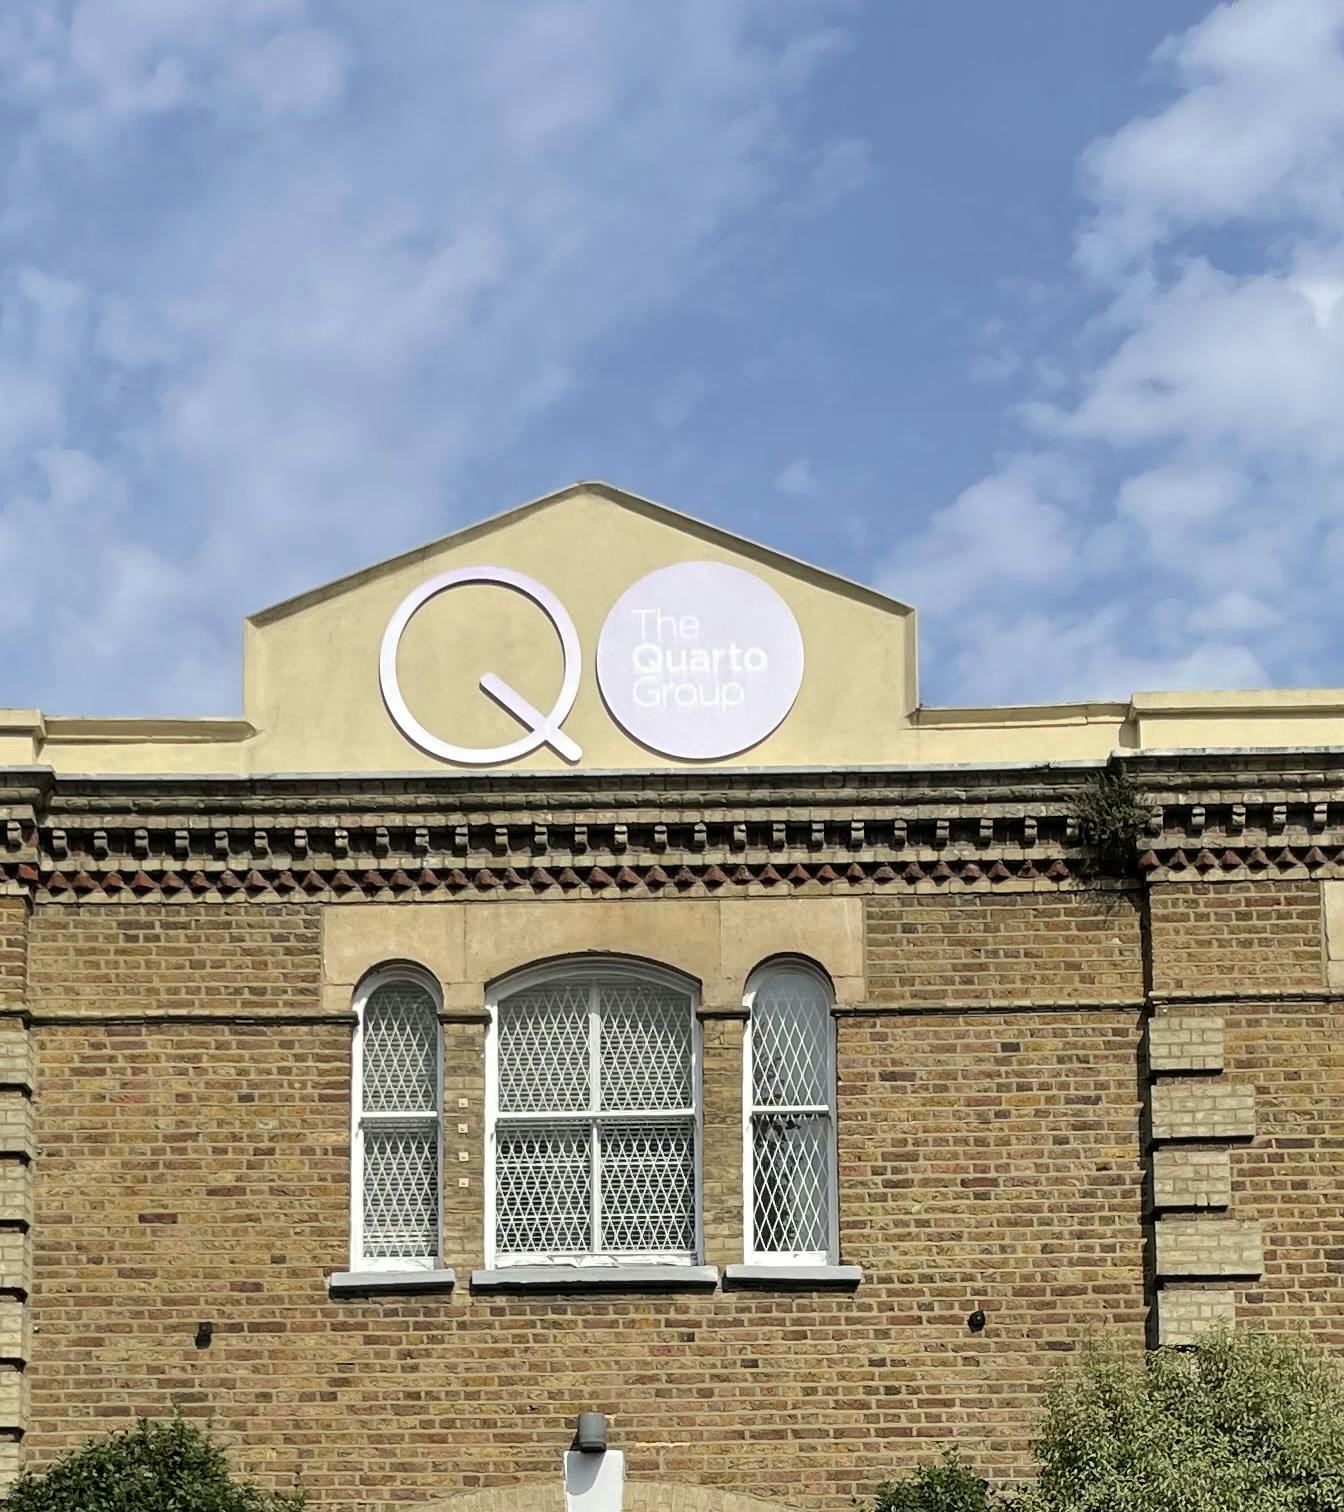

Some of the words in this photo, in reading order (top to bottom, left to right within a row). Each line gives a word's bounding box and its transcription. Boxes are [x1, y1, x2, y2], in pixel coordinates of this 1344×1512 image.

[631, 608, 701, 641] The
[380, 566, 582, 765] Q
[631, 642, 769, 674] Quarto
[632, 675, 746, 713] Group
